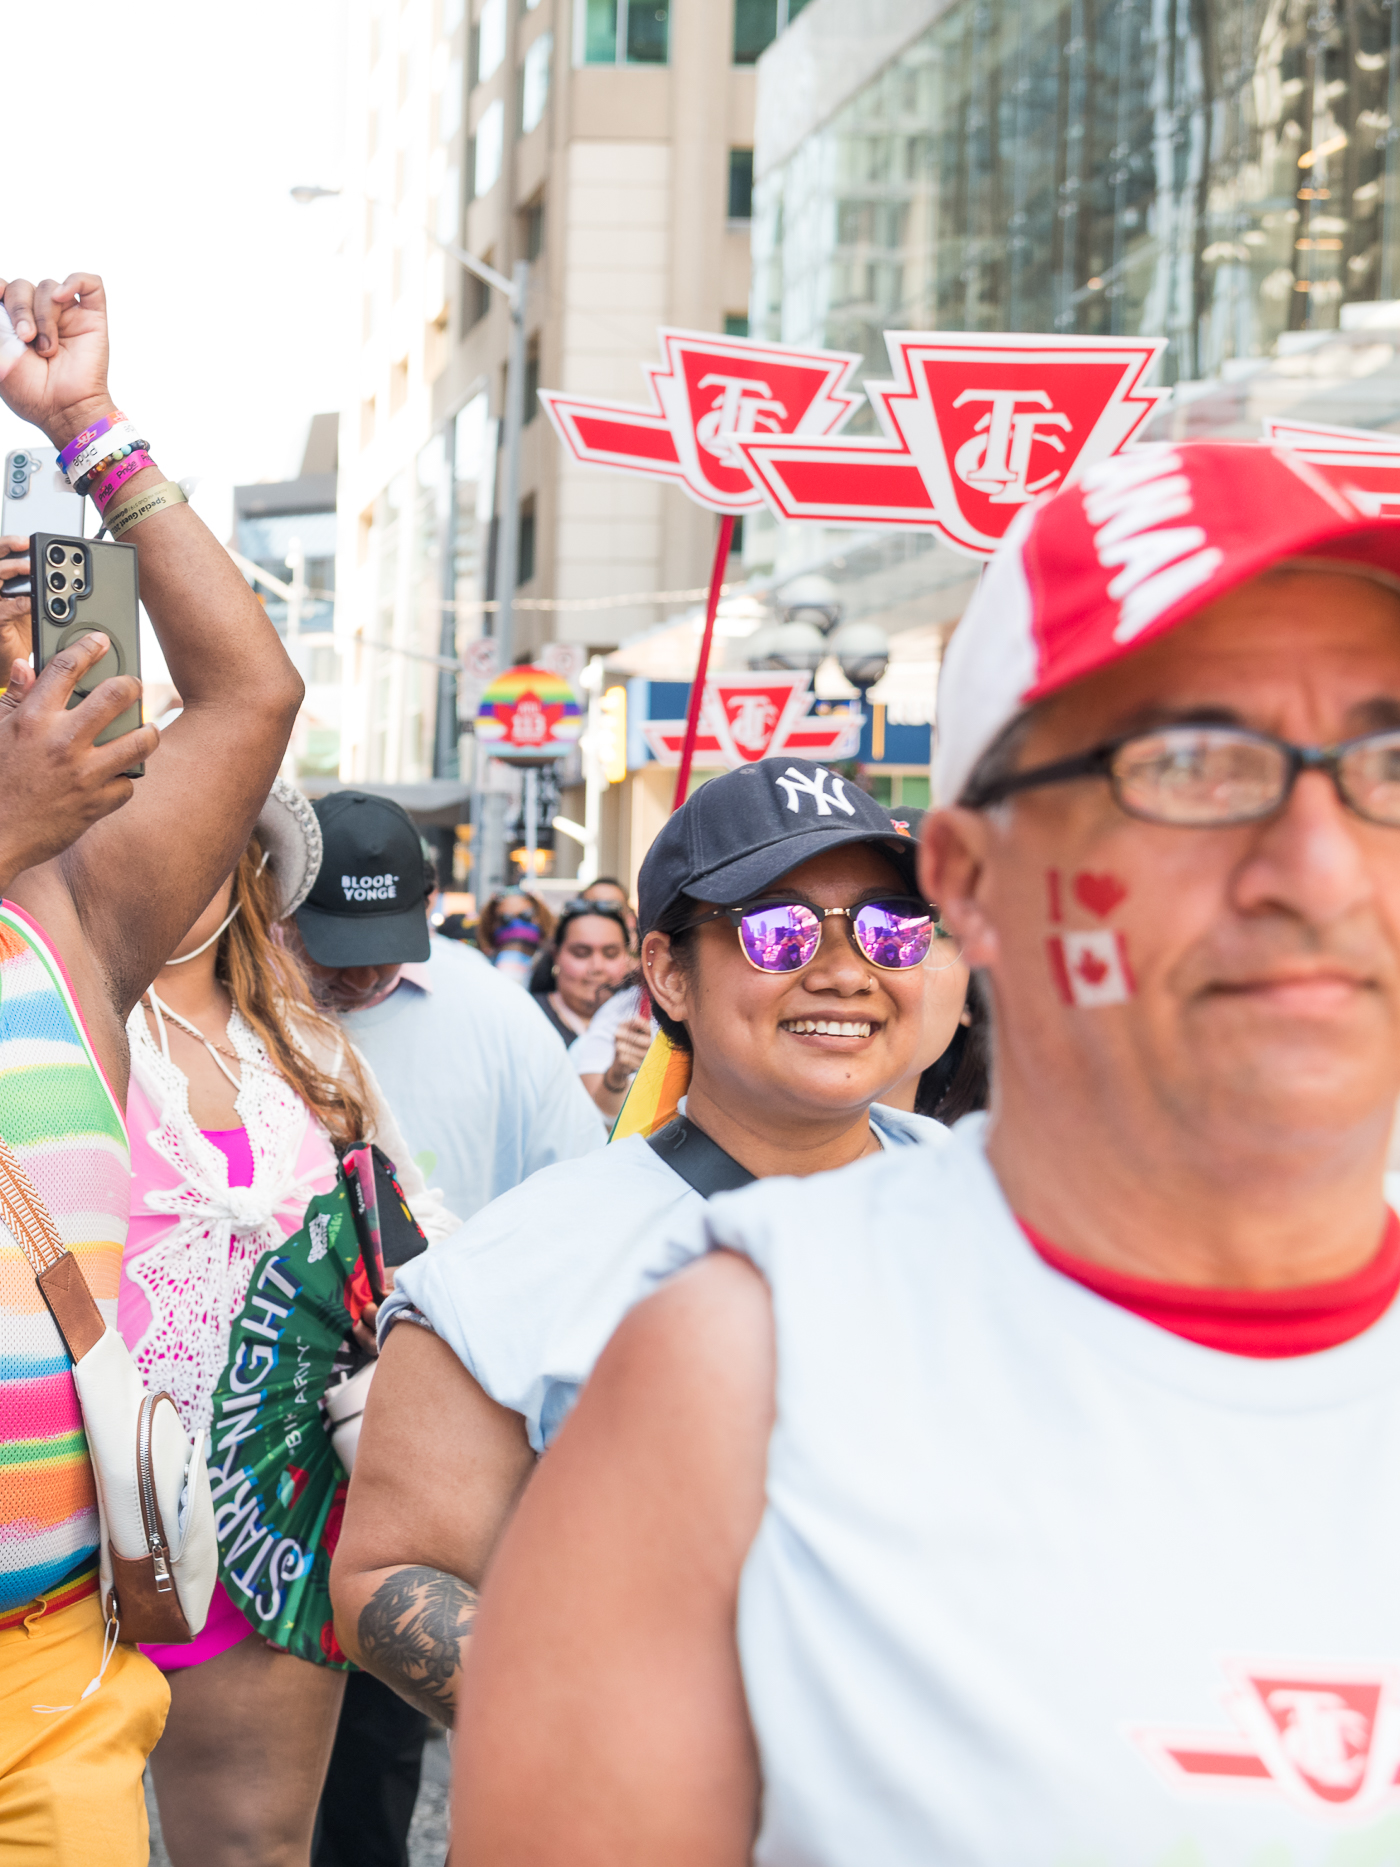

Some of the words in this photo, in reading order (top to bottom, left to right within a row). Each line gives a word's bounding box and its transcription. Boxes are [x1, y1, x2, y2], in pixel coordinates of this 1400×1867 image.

[138, 496, 167, 516] Special
[120, 511, 138, 528] Guest
[775, 766, 856, 817] NY
[341, 873, 400, 889] BLOOR-
[343, 885, 398, 901] YONGE
[216, 1256, 302, 1451] NIGHT
